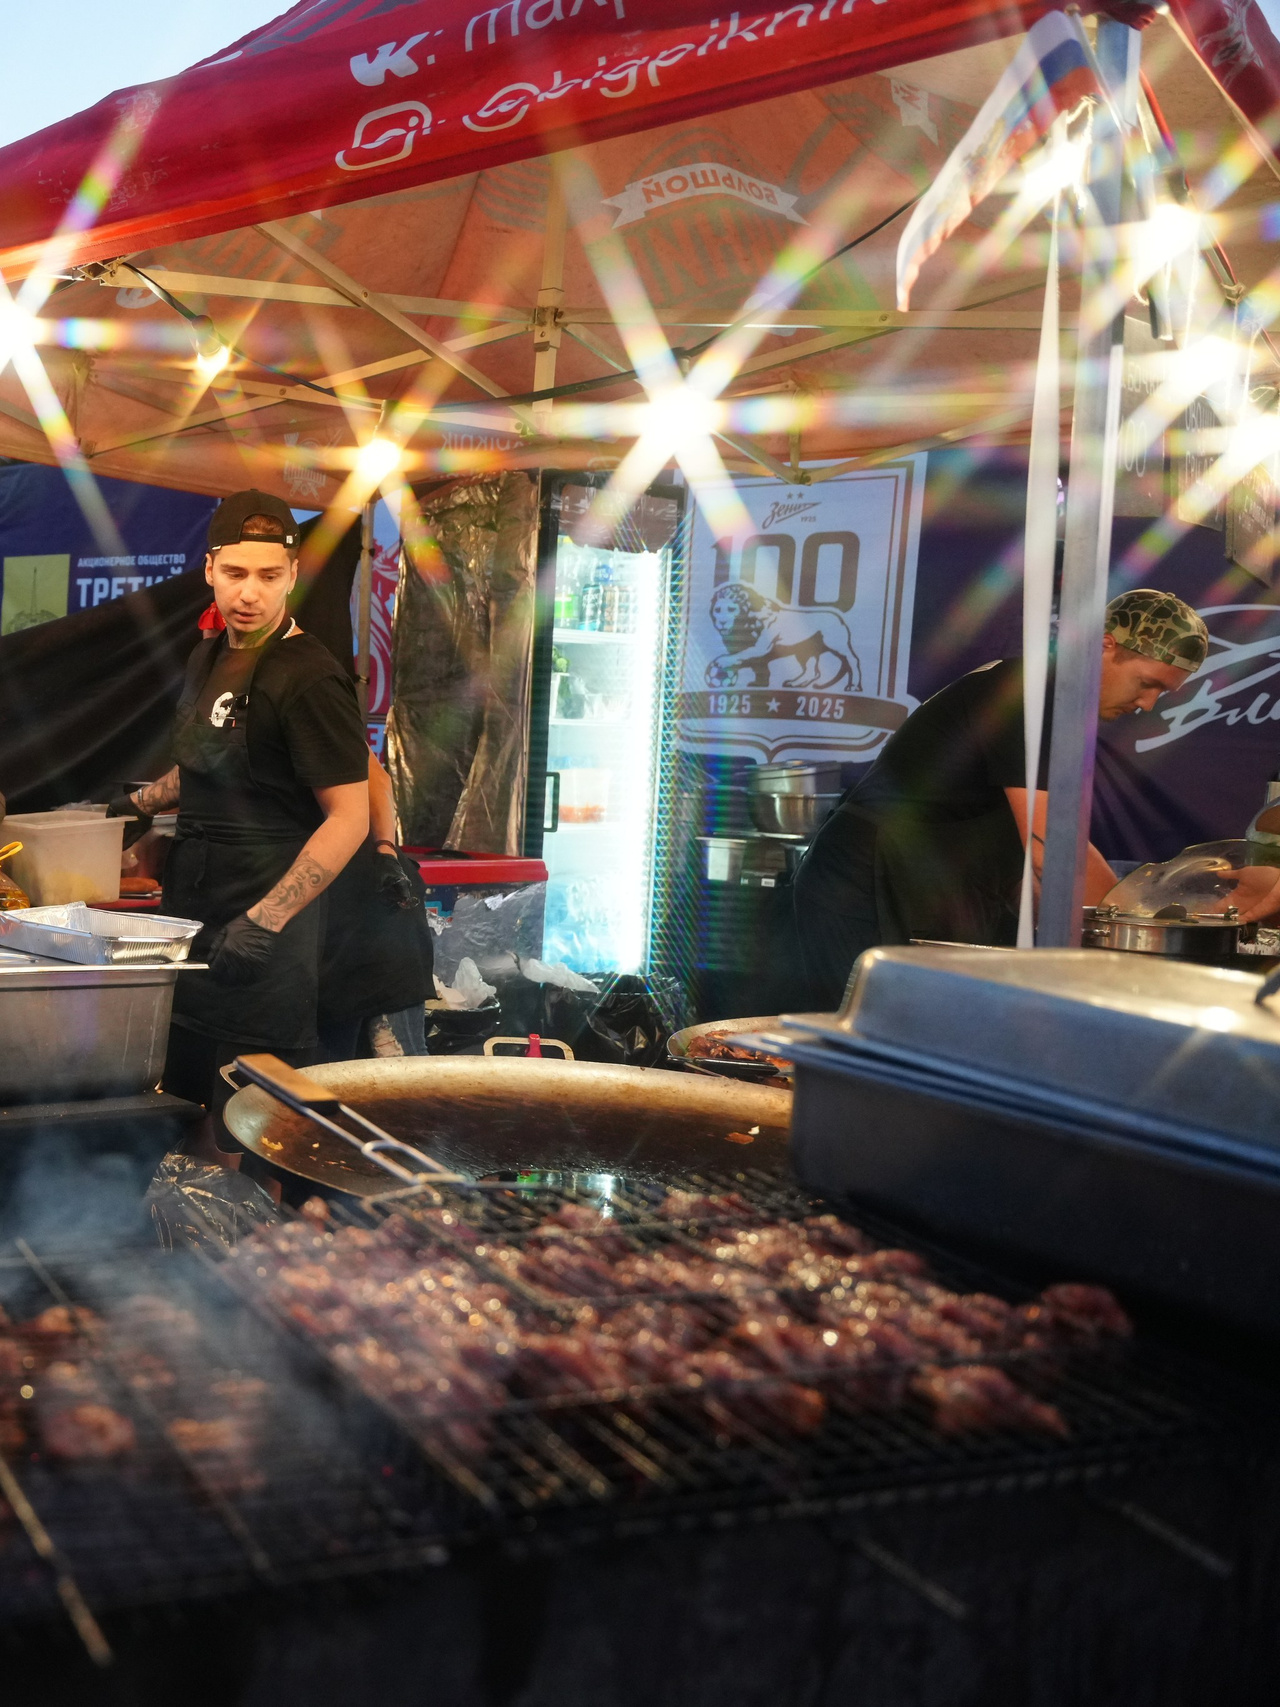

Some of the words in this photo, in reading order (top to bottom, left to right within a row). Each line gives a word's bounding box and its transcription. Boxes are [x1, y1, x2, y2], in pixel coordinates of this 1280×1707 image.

[77, 555, 136, 568] АКЦИОНЕРНОЕ
[137, 553, 186, 566] ОБЩЕСТВО
[711, 531, 860, 613] 100
[708, 694, 751, 715] 1925
[795, 695, 845, 720] 2025
